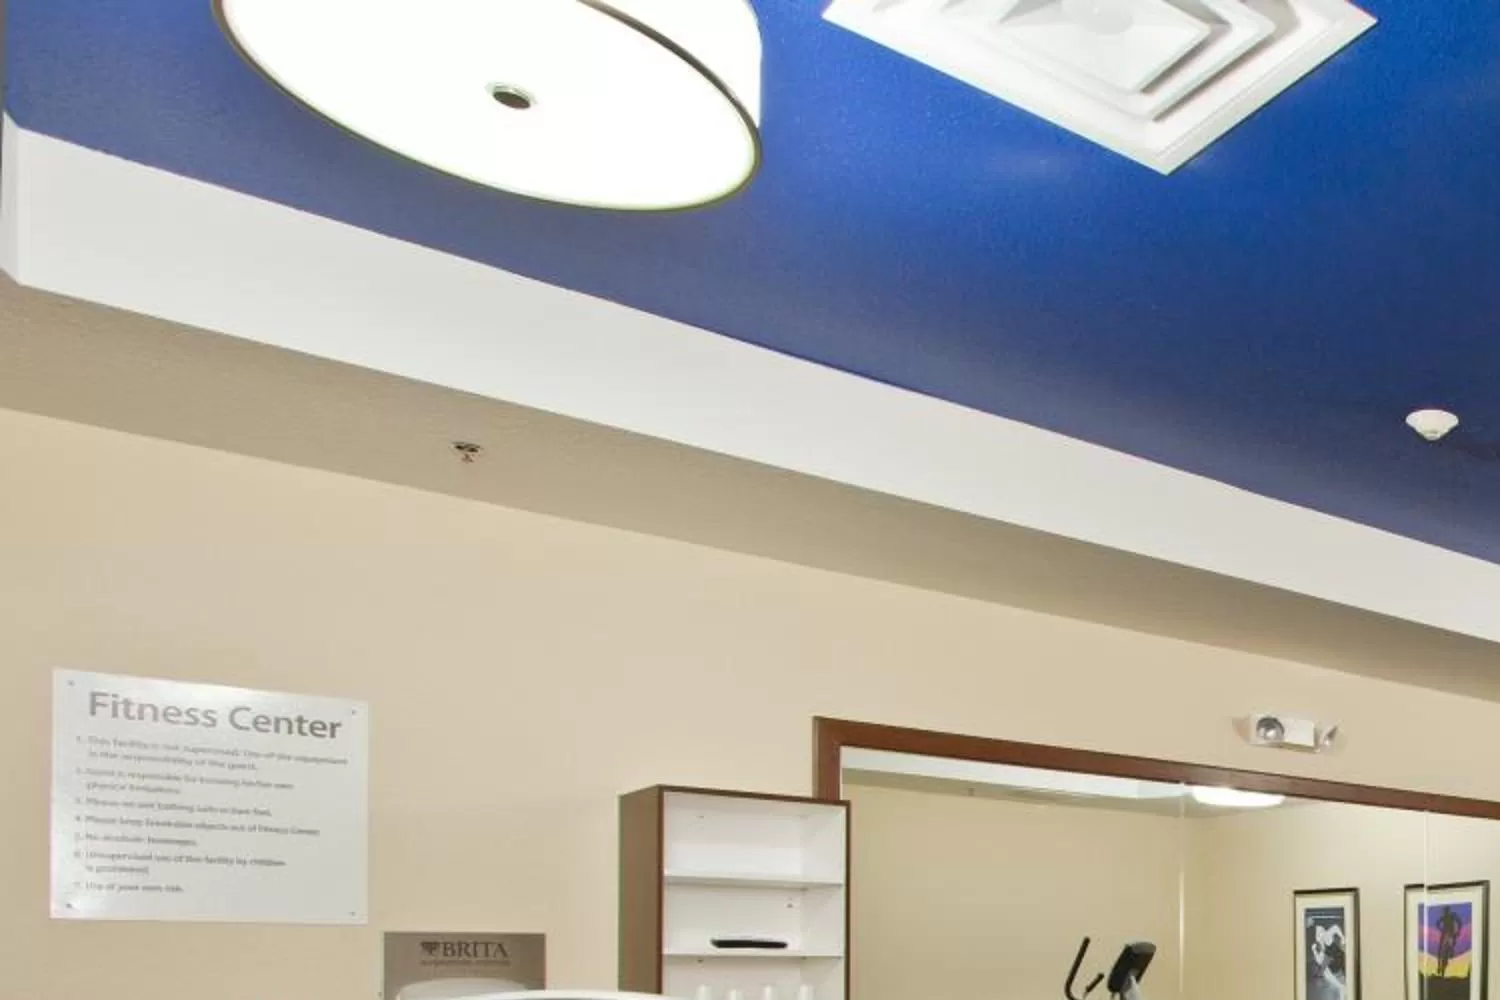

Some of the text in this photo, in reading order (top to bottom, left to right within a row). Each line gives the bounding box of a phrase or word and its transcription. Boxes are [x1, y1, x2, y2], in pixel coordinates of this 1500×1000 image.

[89, 690, 343, 739] Fitness Center
[442, 941, 510, 958] BRITA
